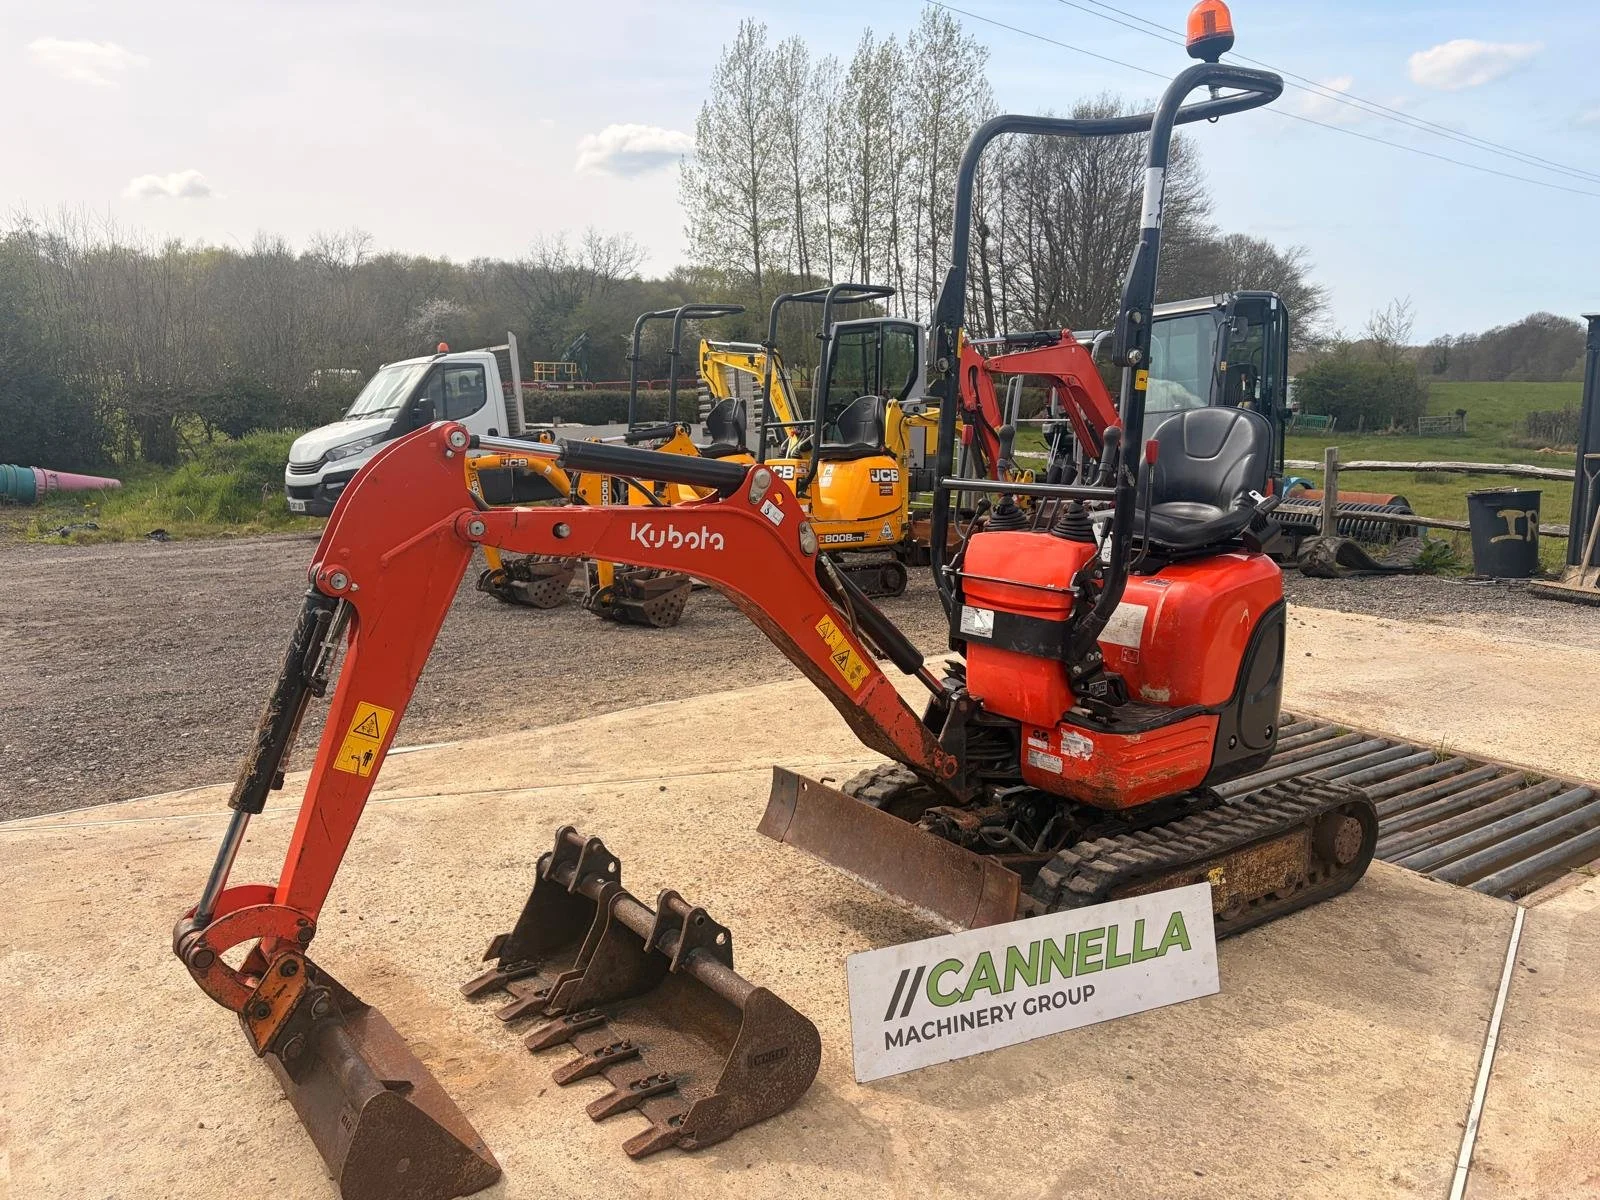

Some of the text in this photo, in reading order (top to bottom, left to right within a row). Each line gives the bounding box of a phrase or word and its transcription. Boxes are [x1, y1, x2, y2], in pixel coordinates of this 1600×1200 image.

[501, 459, 528, 467] JCB
[871, 469, 899, 482] JCB
[630, 522, 724, 550] Kubota
[926, 910, 1192, 1007] CANNELLA
[884, 983, 1096, 1051] MACHINERY GROUP
